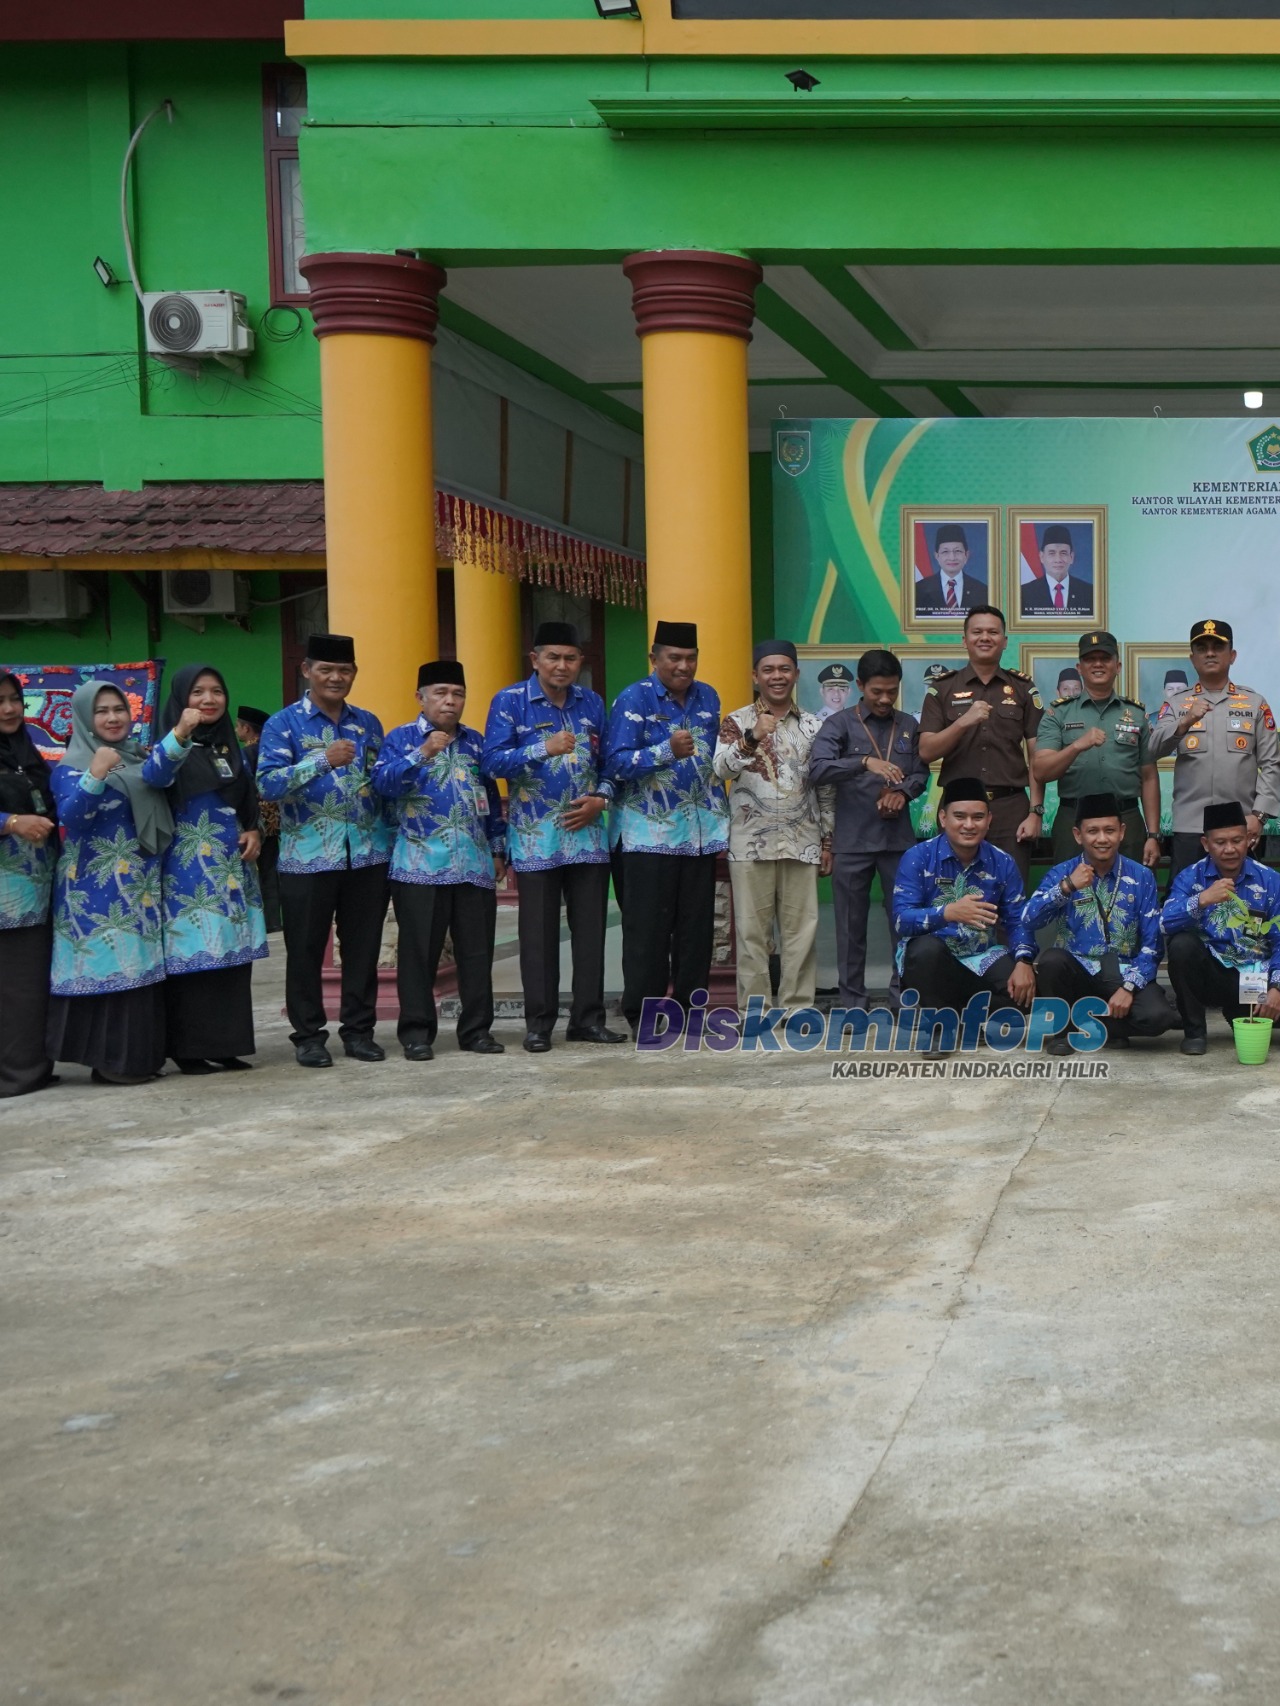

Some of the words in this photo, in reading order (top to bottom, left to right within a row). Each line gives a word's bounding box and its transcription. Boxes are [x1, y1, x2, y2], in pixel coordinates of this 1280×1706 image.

[1131, 496, 1174, 505] KANTOR
[1176, 496, 1222, 505] WILAYAH
[1141, 507, 1178, 516] KANTOR
[1180, 507, 1243, 515] KEMENTERIAN
[1246, 507, 1277, 515] AGAMA
[1228, 710, 1253, 718] POLRI
